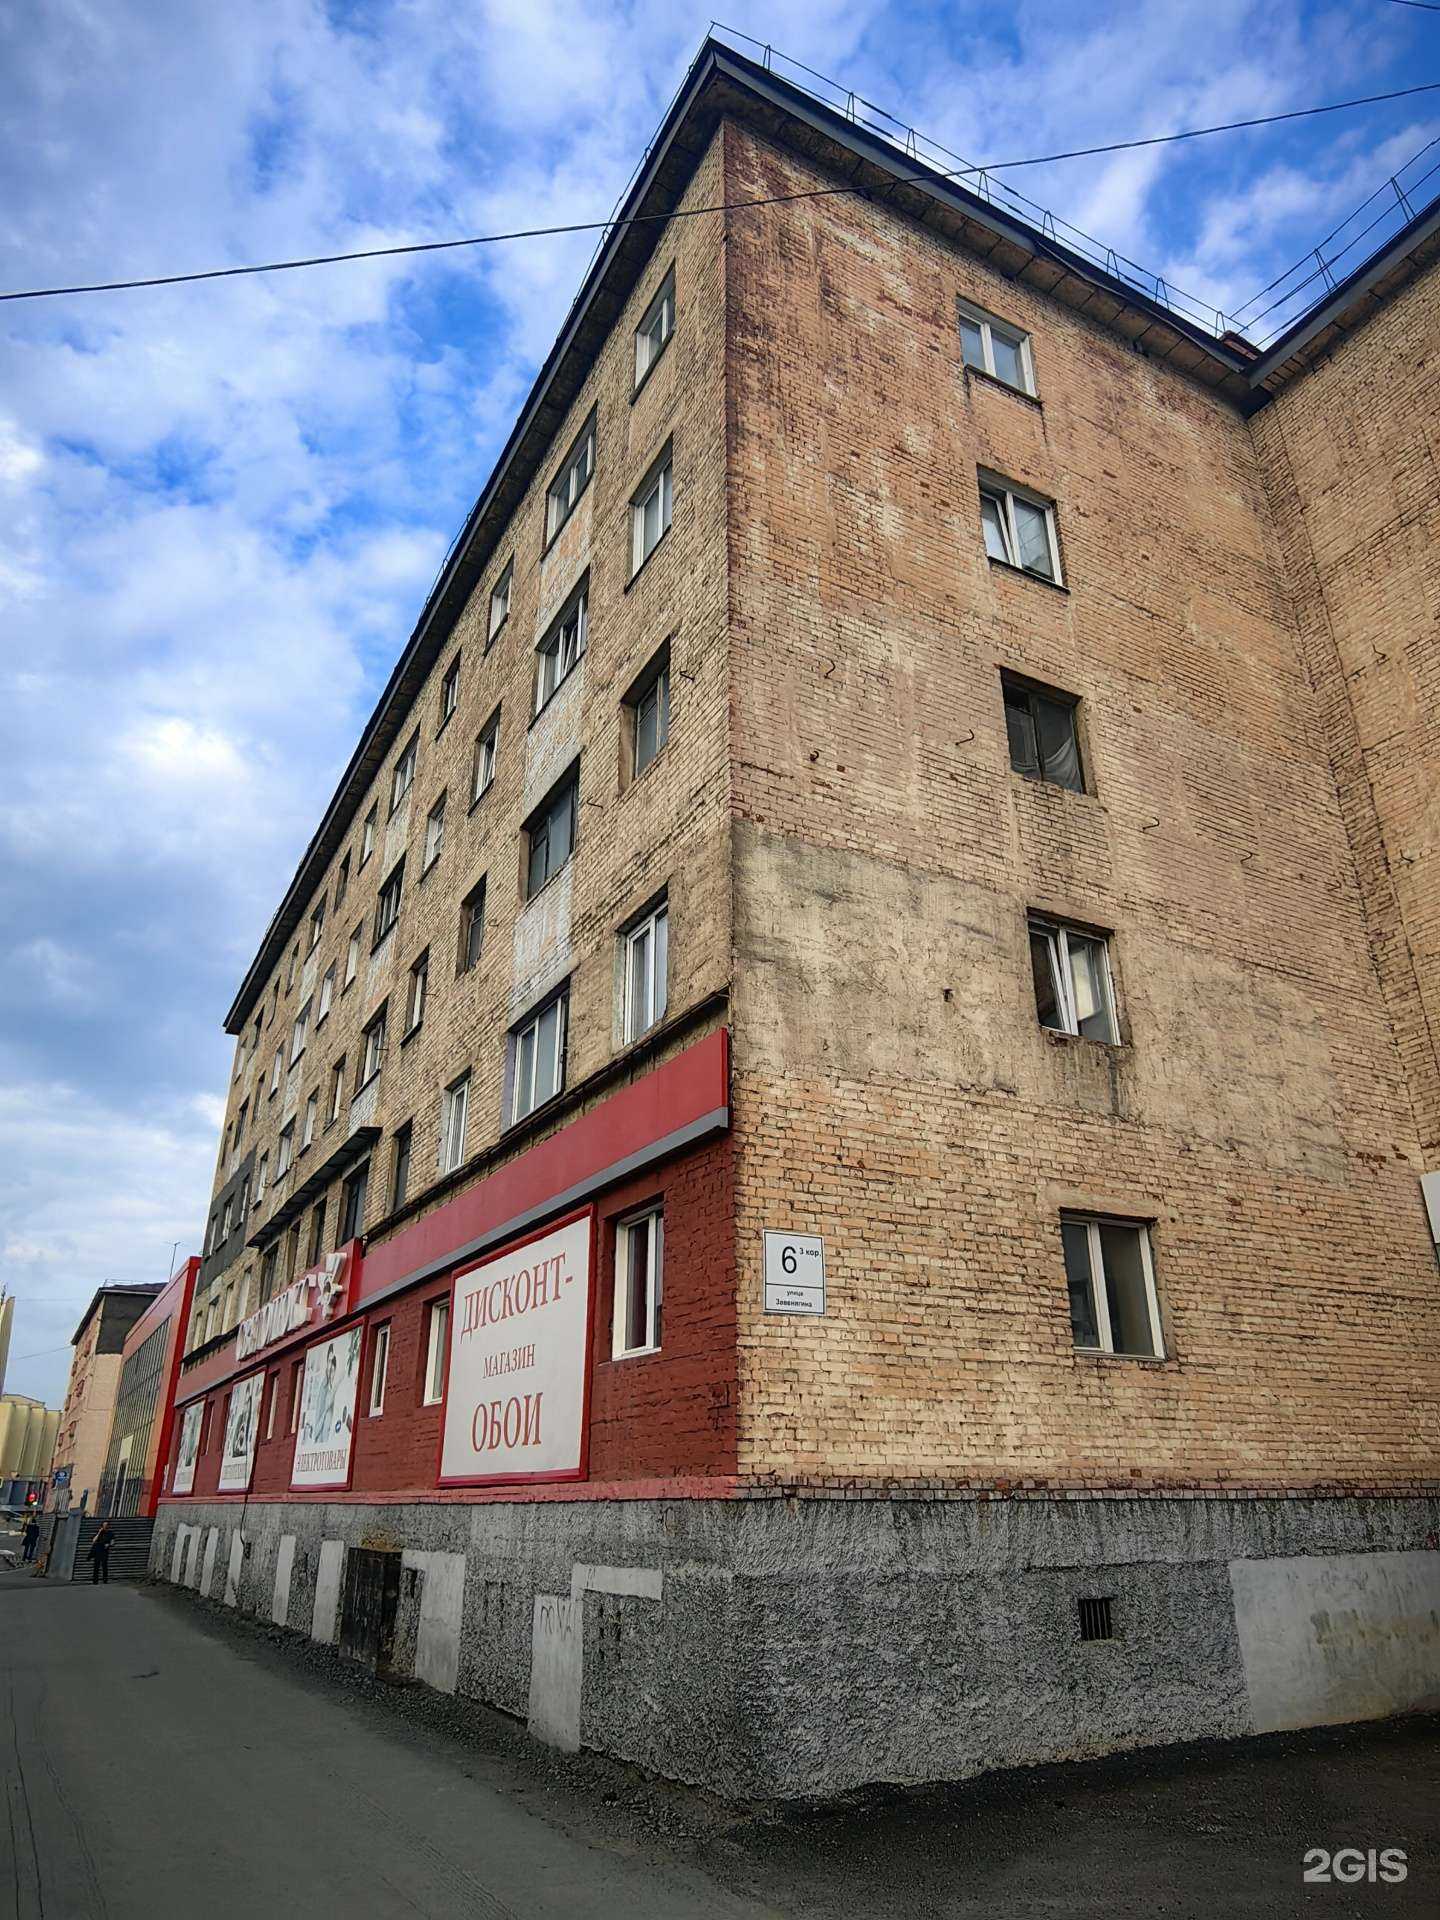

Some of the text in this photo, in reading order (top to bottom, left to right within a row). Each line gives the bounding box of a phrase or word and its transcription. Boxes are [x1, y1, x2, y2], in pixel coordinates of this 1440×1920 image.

[781, 1245, 822, 1274] 6 3 кор.
[460, 1252, 573, 1344] ДИСКОНТ-
[776, 1298, 813, 1308] Завенягина
[482, 1343, 536, 1380] МАГАЗИН
[471, 1391, 544, 1452] ОБОИ
